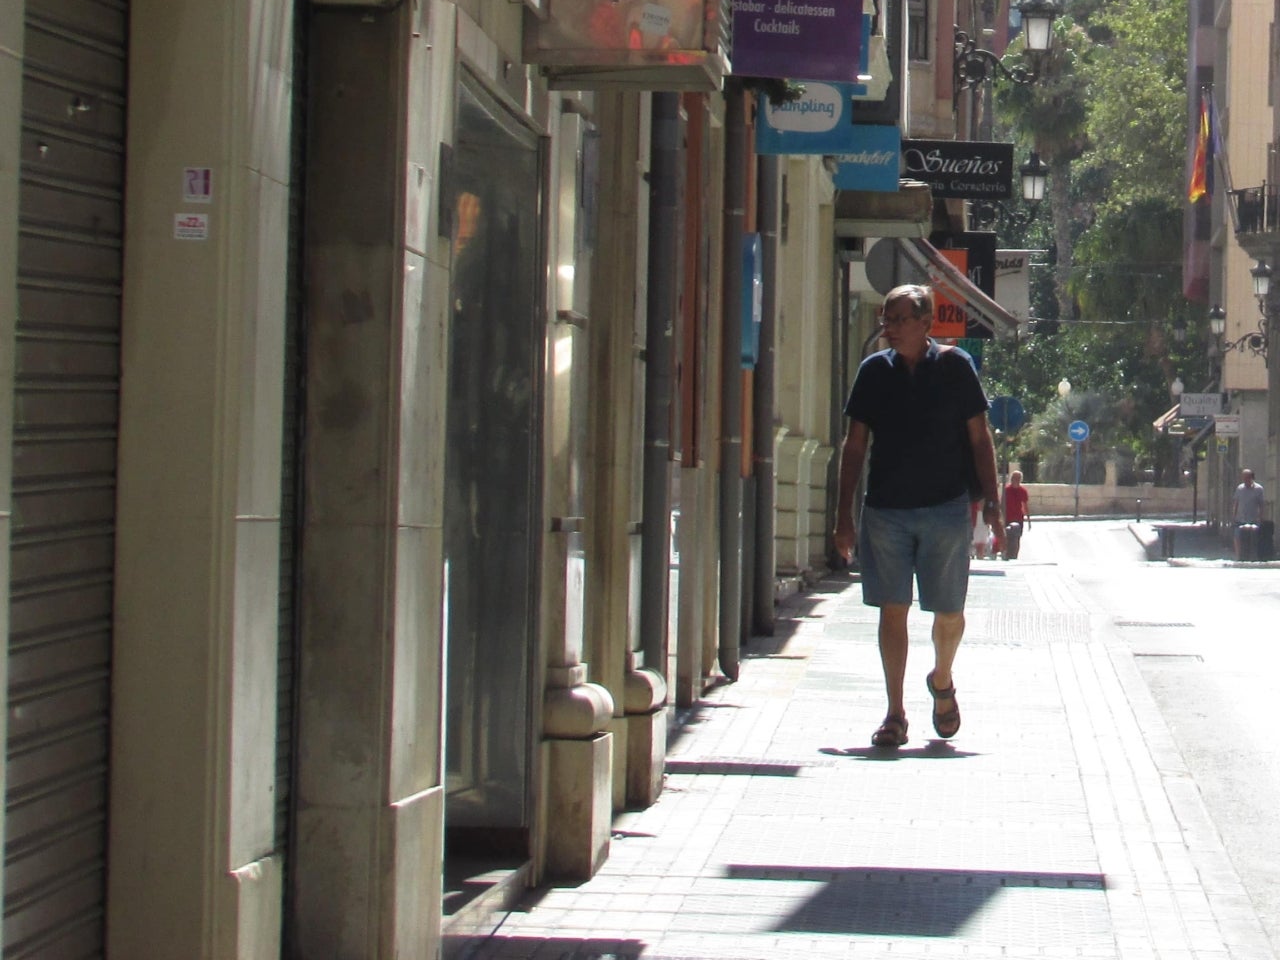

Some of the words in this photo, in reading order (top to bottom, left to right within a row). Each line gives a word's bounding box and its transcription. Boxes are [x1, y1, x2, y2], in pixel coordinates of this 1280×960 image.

[774, 1, 836, 17] delicatessen
[754, 19, 801, 34] Cocktails
[904, 148, 1003, 175] Sueños
[1184, 395, 1218, 406] Quality
